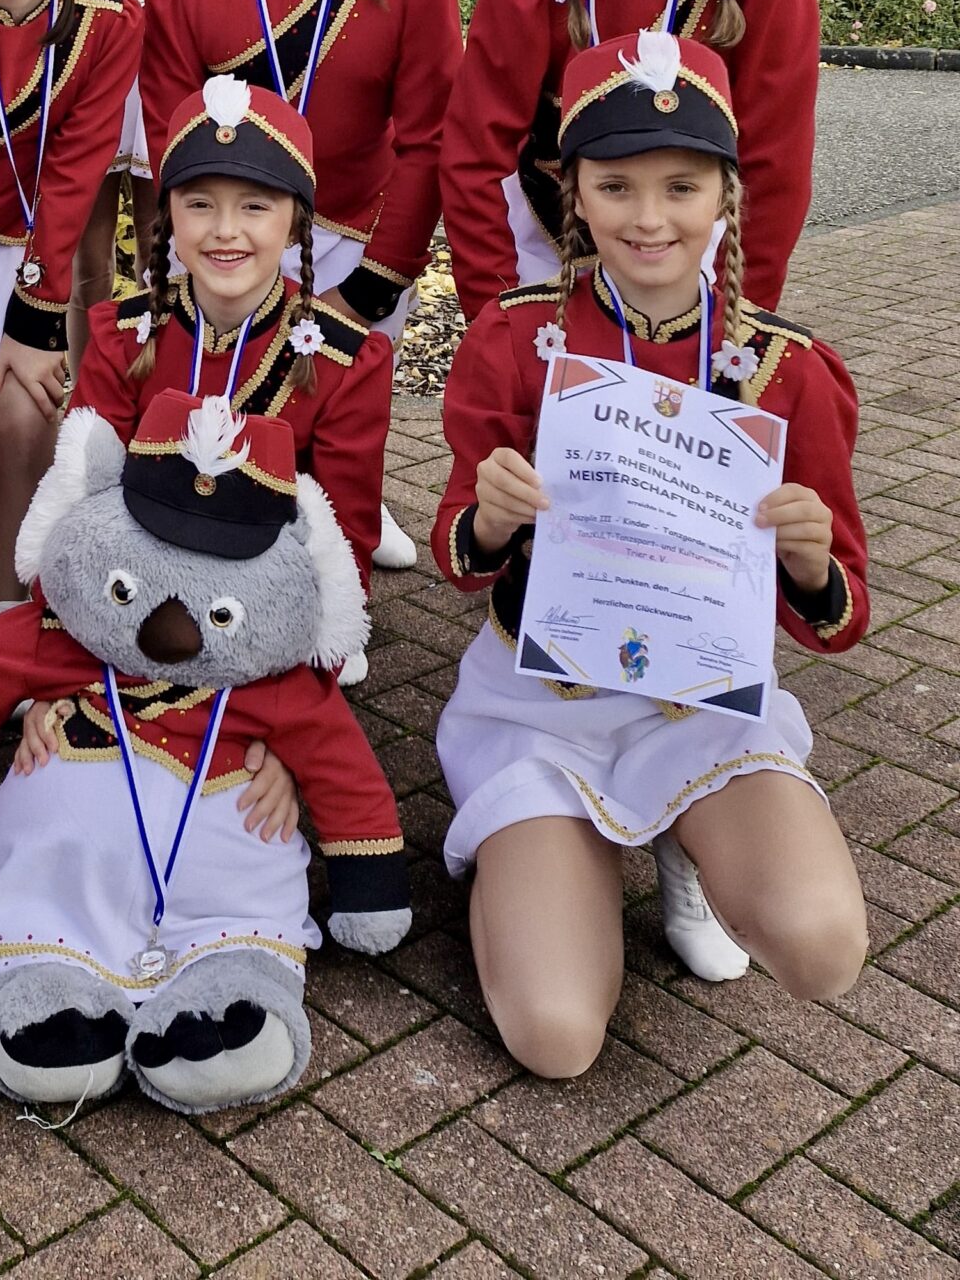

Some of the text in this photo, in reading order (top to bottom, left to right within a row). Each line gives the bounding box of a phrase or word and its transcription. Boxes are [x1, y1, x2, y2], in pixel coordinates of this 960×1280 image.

[594, 404, 733, 468] URKUNDE
[638, 447, 682, 472] BEI DEN
[617, 454, 751, 517] RHEINLAND-PFALZ
[569, 469, 745, 531] MEISTERSCHAFTEN 2026
[663, 526, 707, 547] Tanzgarde
[652, 583, 670, 593] den
[703, 595, 726, 608] Platz
[592, 598, 694, 623] Herzlichen Glückwunsch
